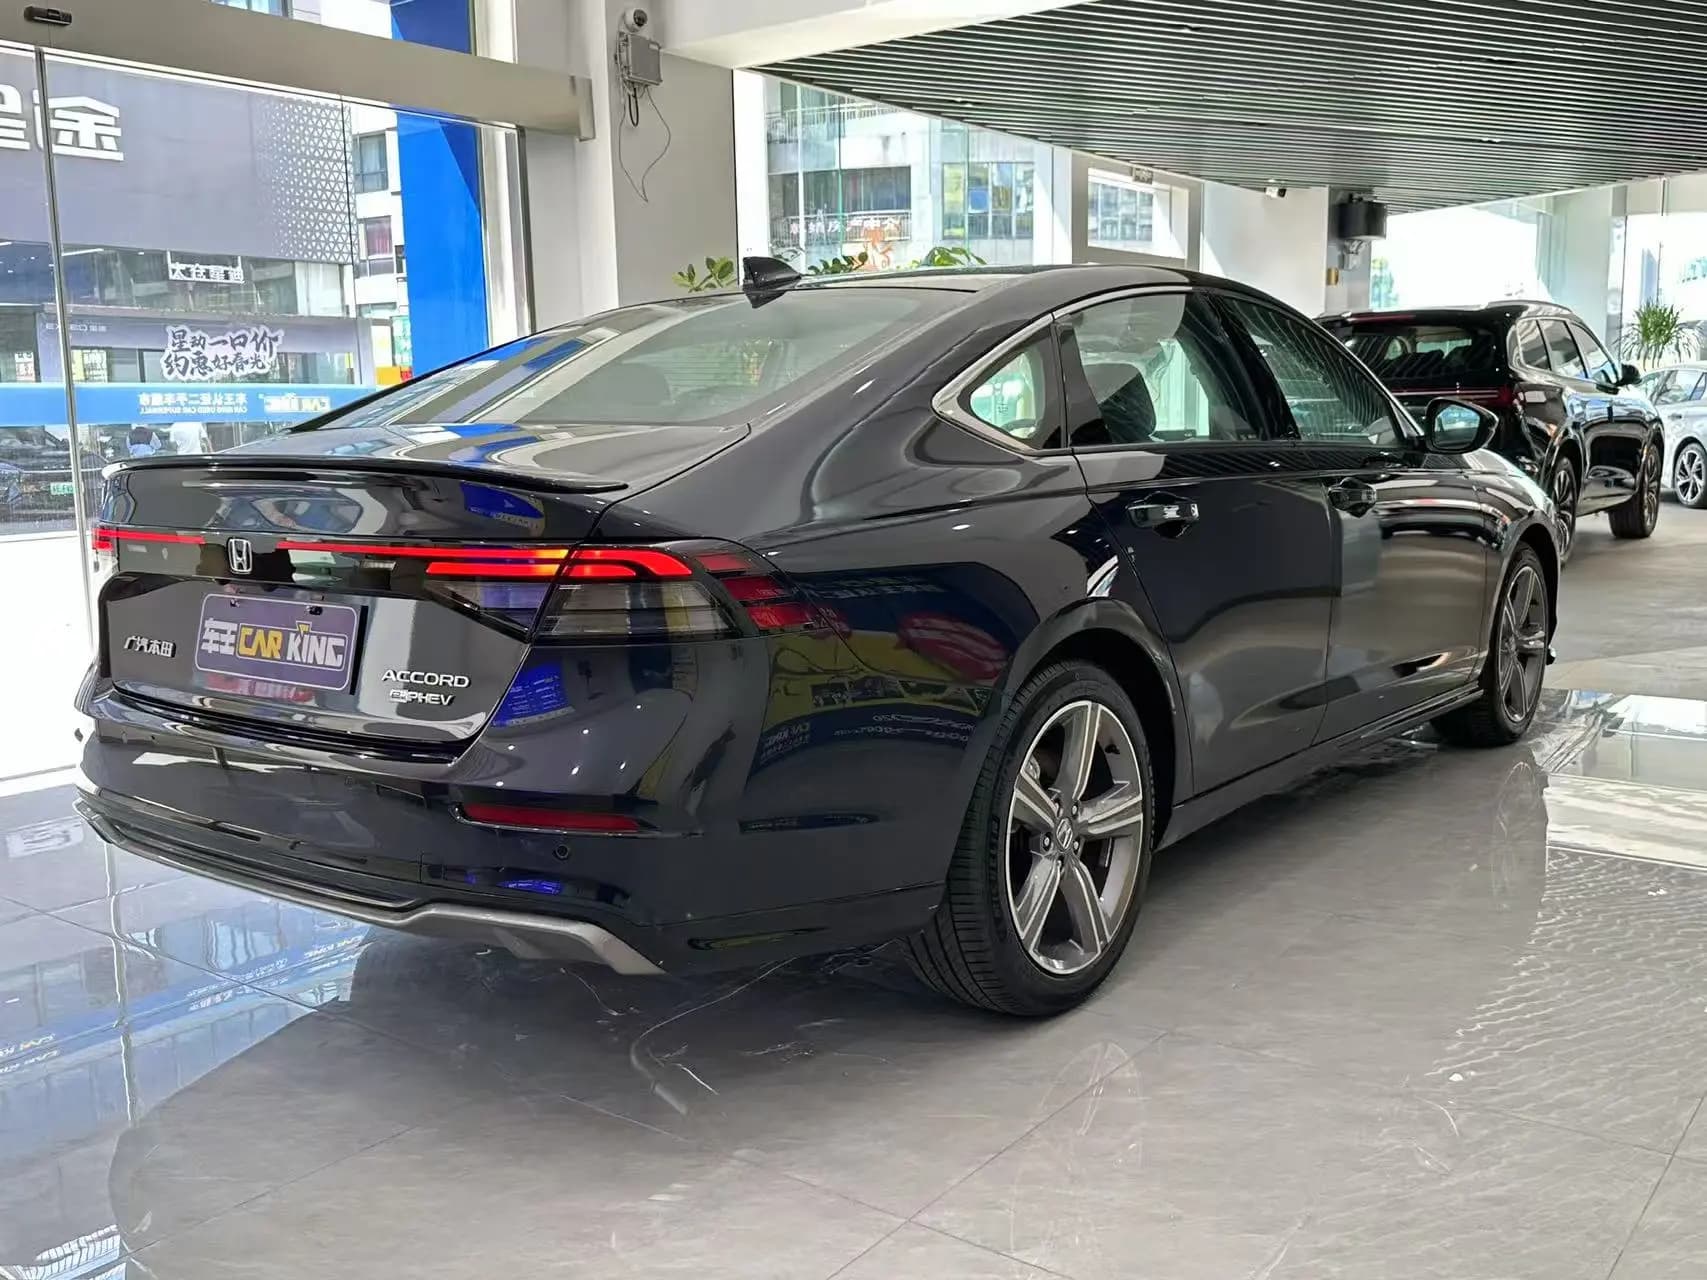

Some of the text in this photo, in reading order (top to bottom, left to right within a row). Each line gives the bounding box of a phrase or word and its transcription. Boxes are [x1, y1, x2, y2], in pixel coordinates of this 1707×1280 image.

[171, 328, 279, 359] 星动一口价
[124, 635, 173, 657] 广汽本田
[238, 626, 345, 667] CAR KING
[381, 669, 470, 688] ACCORD
